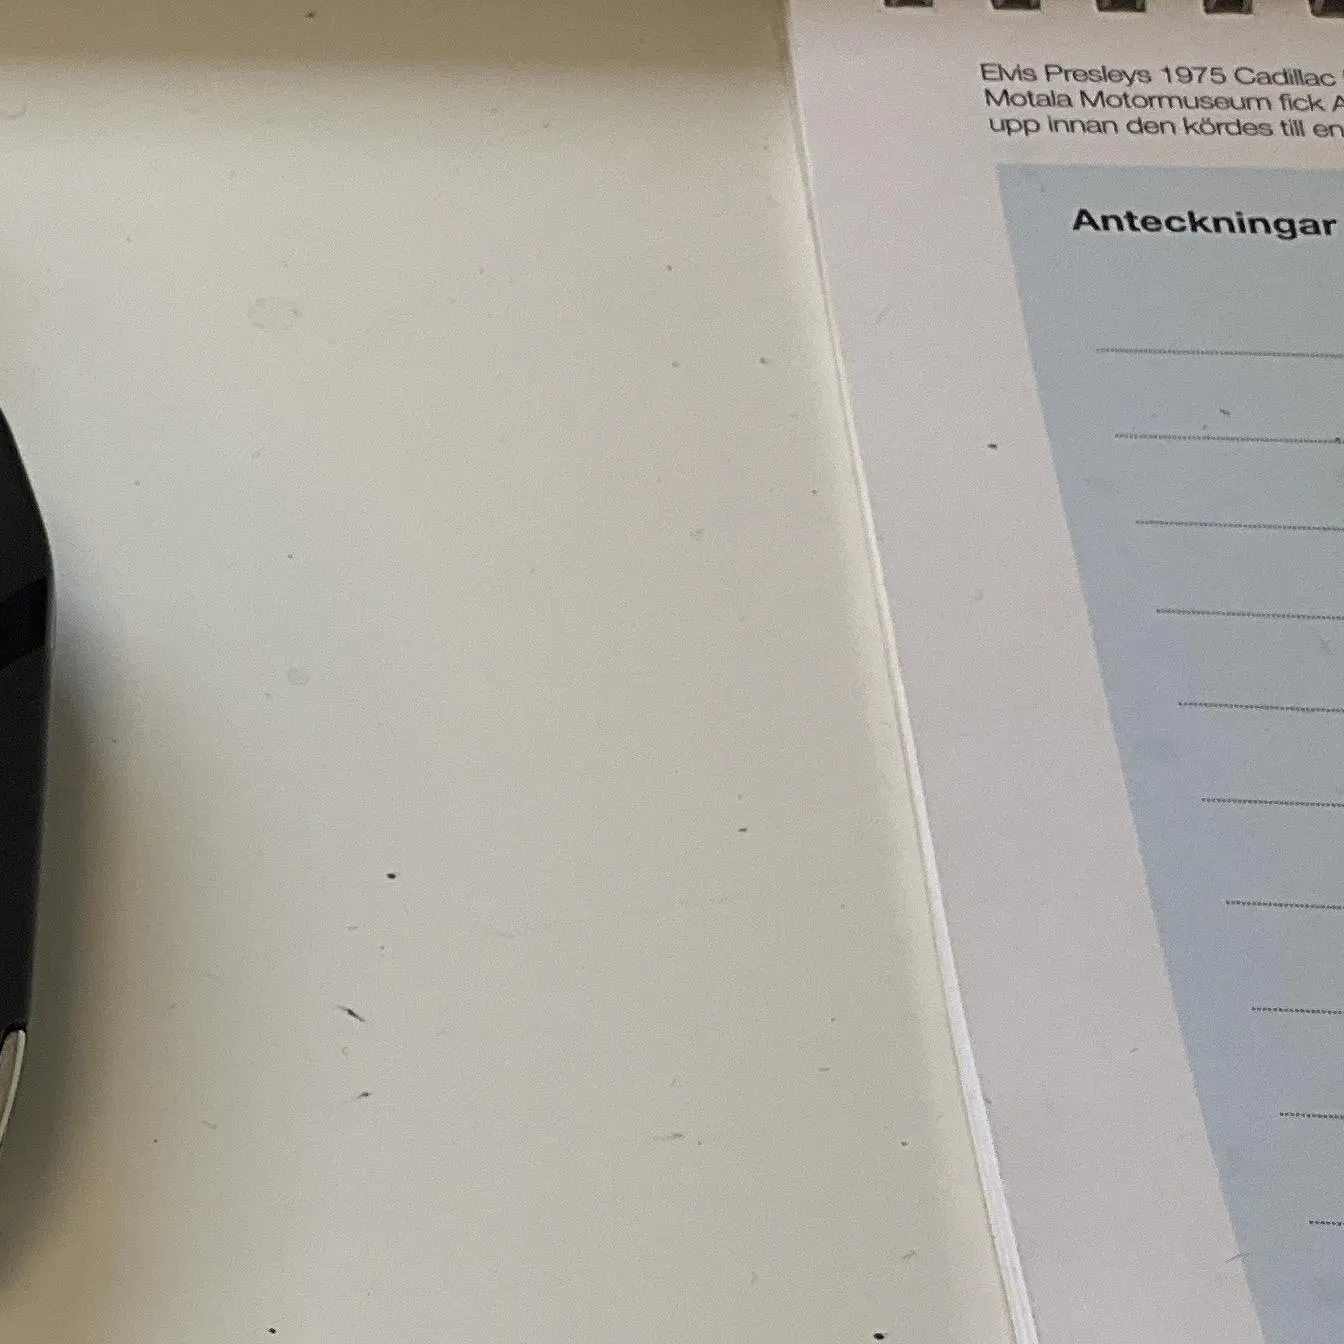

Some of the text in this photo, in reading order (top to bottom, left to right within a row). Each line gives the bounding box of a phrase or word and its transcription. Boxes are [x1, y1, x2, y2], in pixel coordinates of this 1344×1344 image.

[980, 62, 1038, 82] Elvis
[1045, 63, 1152, 87] Presleys
[1161, 66, 1227, 85] 1975
[1234, 66, 1337, 87] Cadillac
[985, 88, 1073, 108] Motala
[1080, 90, 1272, 111] Motormuseum
[1280, 94, 1325, 113] fick
[989, 116, 1040, 136] upp
[1048, 114, 1118, 135] innan
[1126, 115, 1176, 136] den
[1182, 117, 1274, 137] kördes
[1280, 119, 1306, 138] till
[1073, 208, 1337, 240] Anteckningar
